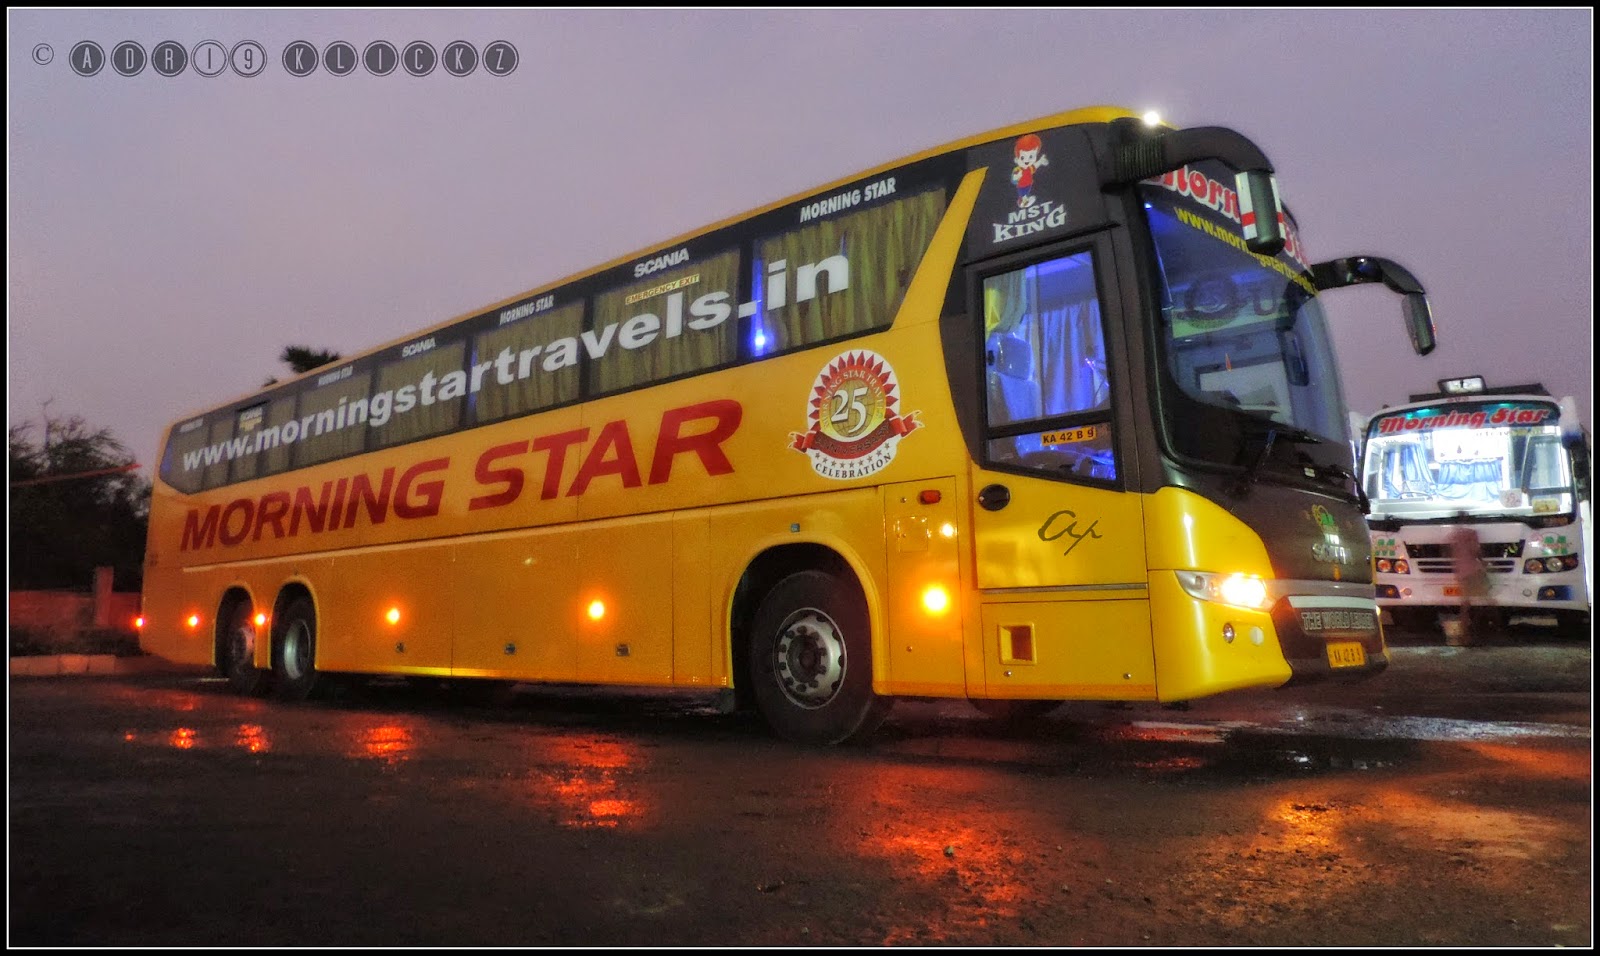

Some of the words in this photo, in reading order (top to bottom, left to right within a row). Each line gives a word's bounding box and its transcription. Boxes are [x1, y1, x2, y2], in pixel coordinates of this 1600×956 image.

[800, 189, 861, 222] MORNING
[863, 177, 897, 201] STAR
[1008, 201, 1053, 224] MST
[993, 204, 1067, 243] KING
[634, 248, 690, 278] SCANIA
[626, 282, 677, 303] EMERGENCY
[679, 275, 699, 288] EXIT
[499, 302, 536, 326] MORNING
[535, 295, 555, 313] STAR
[183, 254, 849, 471] www.morningstartravels.in
[402, 338, 436, 357] SCANIA
[831, 387, 868, 433] 25
[1378, 410, 1488, 434] Morning
[1490, 407, 1550, 425] Star
[1043, 433, 1057, 444] KA
[1059, 431, 1073, 442] 42
[1076, 430, 1084, 439] B
[181, 457, 450, 550] MORNING
[469, 399, 742, 511] STAR
[815, 452, 892, 479] CELEBRATION
